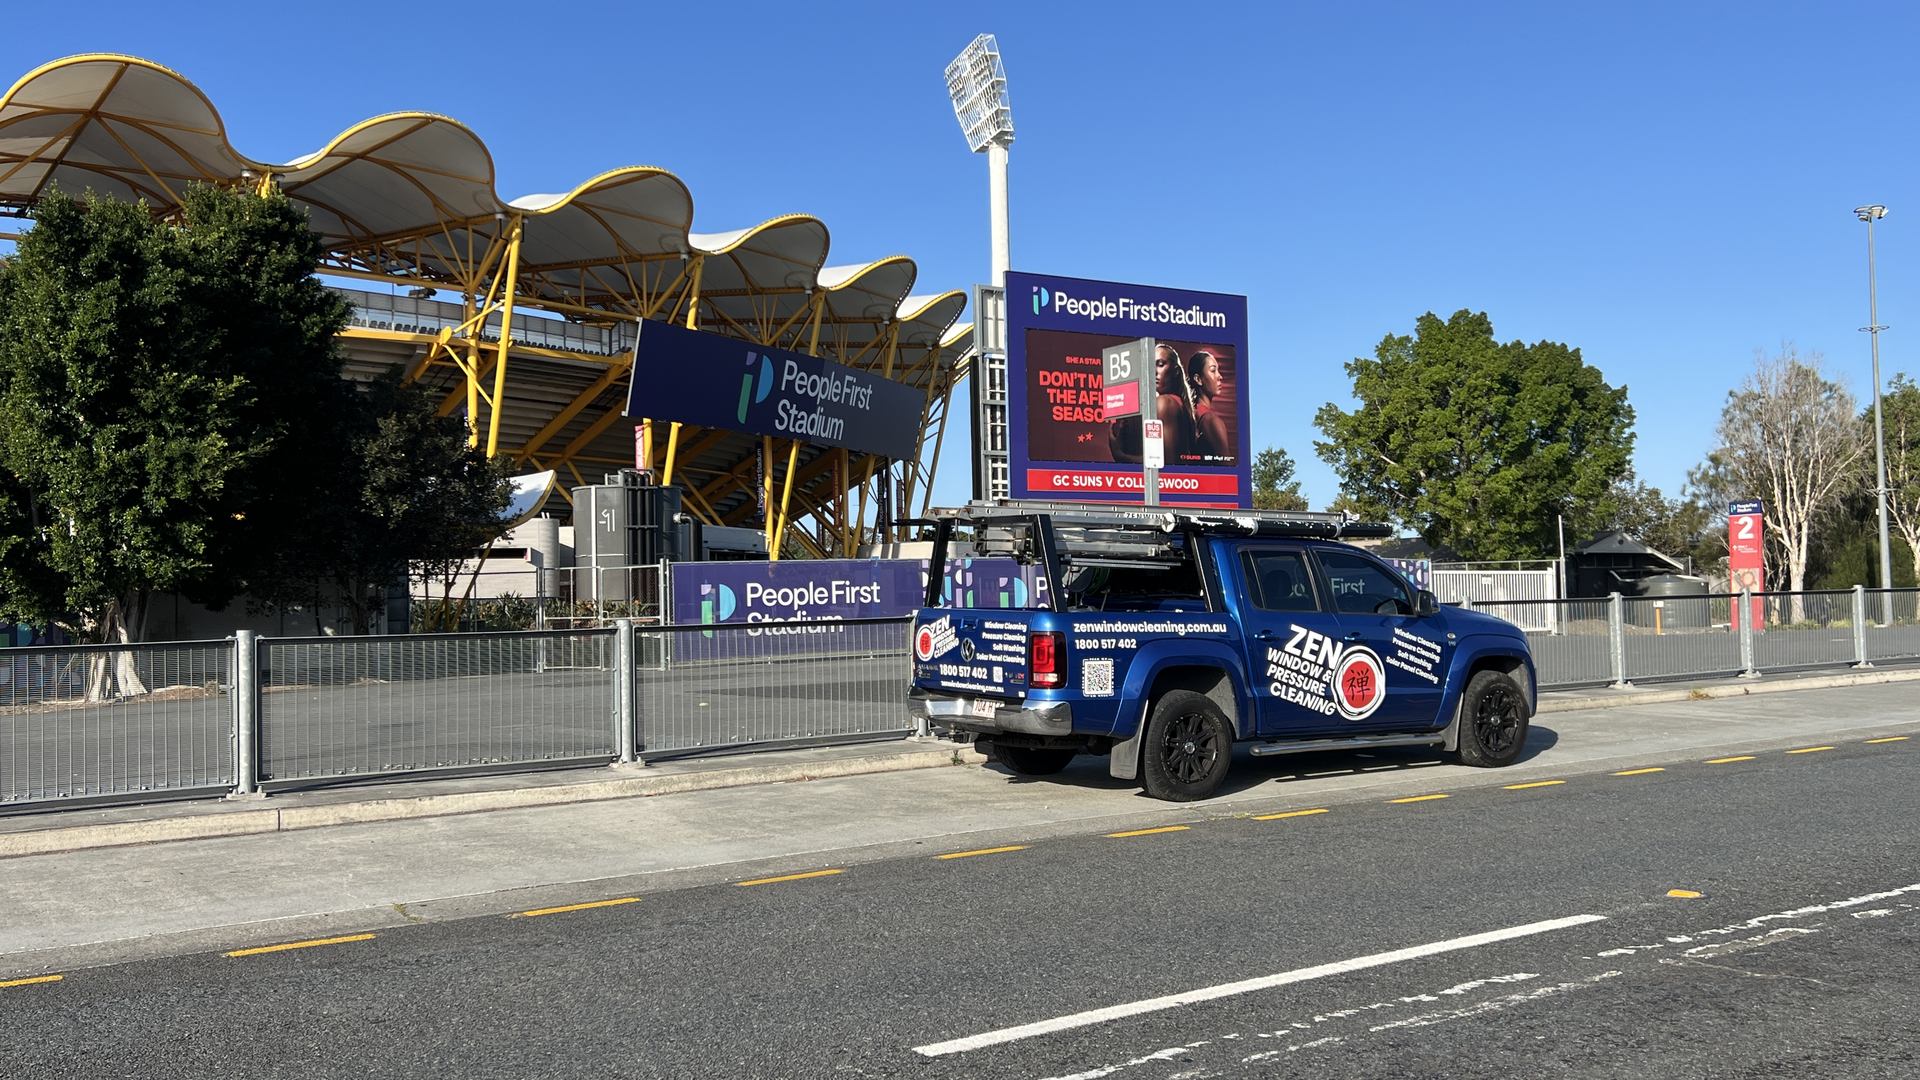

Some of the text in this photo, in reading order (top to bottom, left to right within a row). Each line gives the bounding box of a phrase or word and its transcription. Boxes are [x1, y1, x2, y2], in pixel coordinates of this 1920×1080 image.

[1055, 291, 1226, 328] People First Stadium
[1109, 350, 1131, 381] B5
[781, 359, 873, 411] People First
[1039, 370, 1087, 388] DON'T
[1047, 388, 1104, 406] THE AFL
[774, 398, 845, 441] Stadium
[1052, 405, 1117, 424] SEASO
[1146, 423, 1161, 431] BUS
[1052, 475, 1199, 490] GC SUNS V COLLGWOOD
[1738, 516, 1755, 540] 2
[746, 580, 881, 611] People First
[1331, 577, 1366, 595] First
[746, 611, 844, 637] Stadium
[929, 614, 951, 638] ZEN
[1004, 622, 1027, 633] Cleaning
[1073, 621, 1227, 636] zenwindowcleaning.com.au
[1003, 633, 1026, 643] Cleaning
[1075, 638, 1137, 650] 1800 517 402
[1284, 623, 1344, 671] ZEN
[1392, 636, 1441, 664] Pressure Cleaning
[1394, 627, 1442, 654] Window Cleaning
[939, 663, 958, 676] 1800
[958, 665, 971, 677] 517
[971, 667, 988, 679] 402
[1003, 654, 1026, 666] Cleaning
[1267, 646, 1333, 683] WINDOW &
[1385, 655, 1439, 685] Solar Panel Cleaning
[1397, 649, 1433, 671] Soft Washing
[1266, 663, 1327, 697] PRESSURE
[1269, 682, 1337, 717] CLEANING
